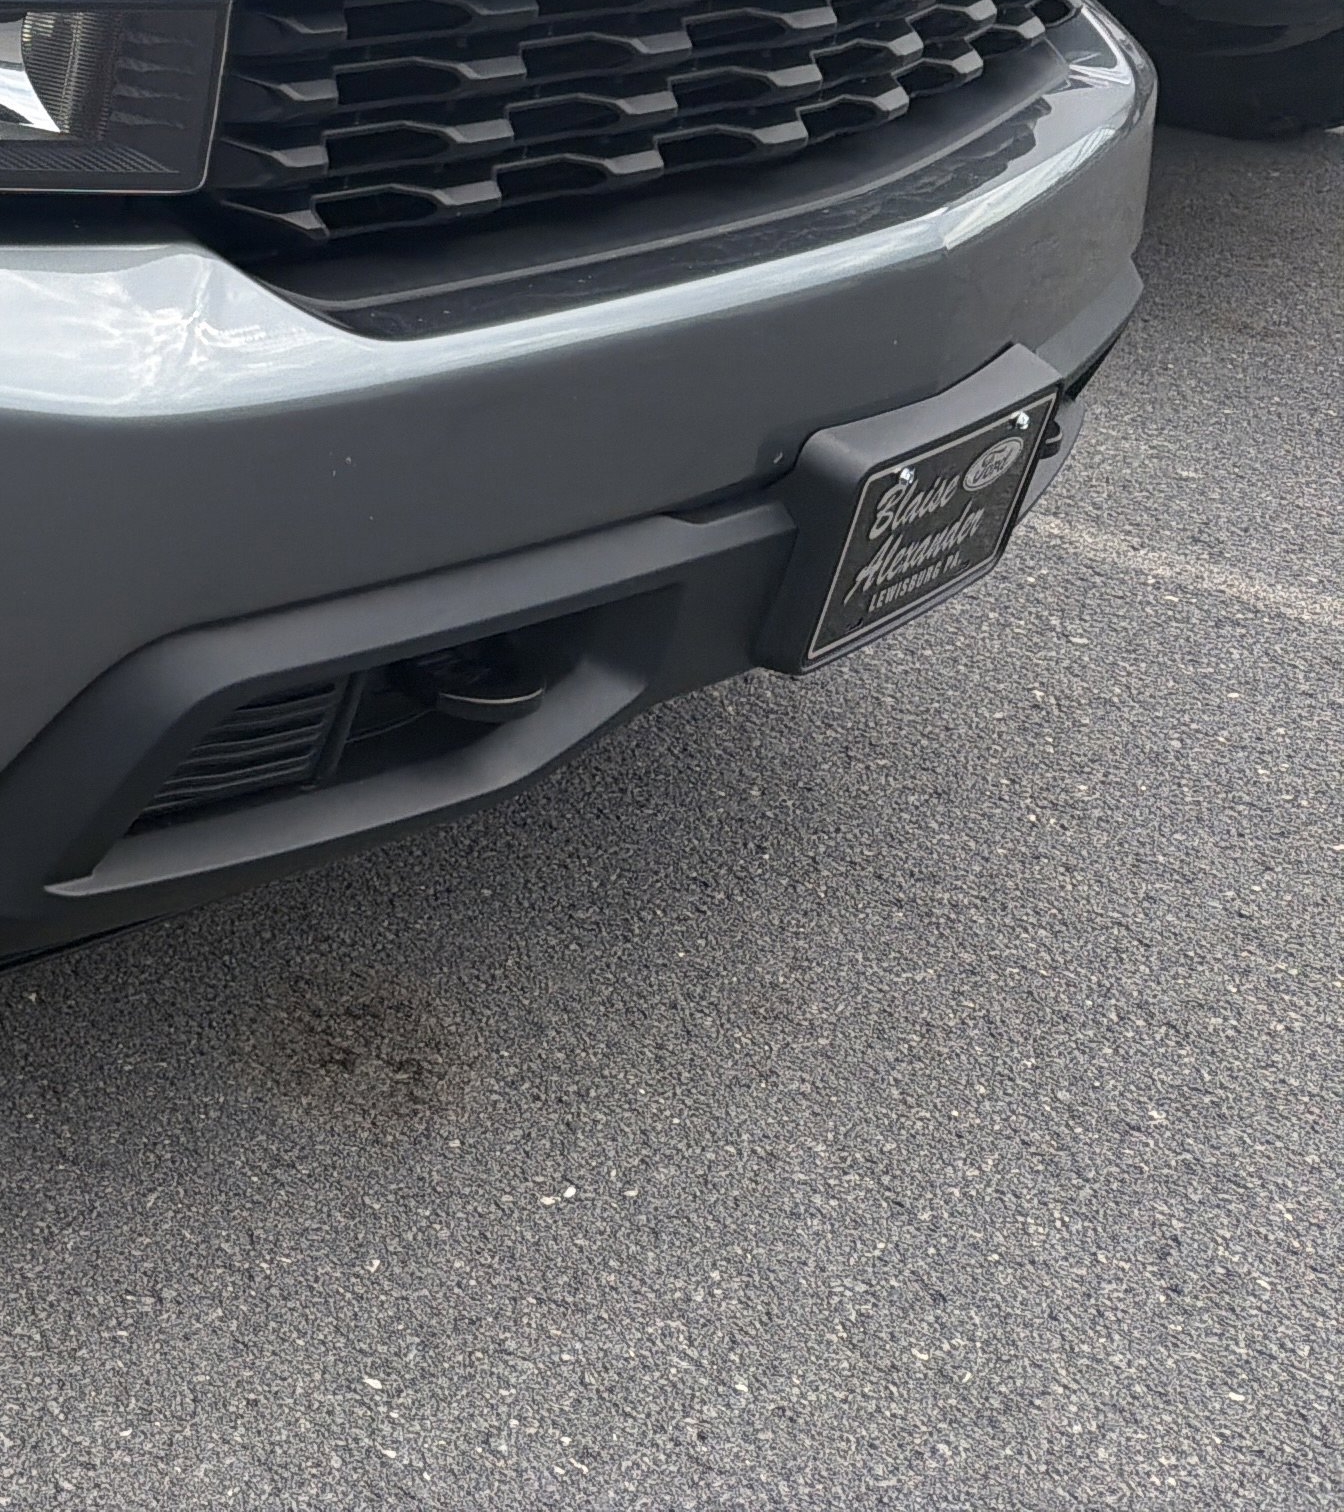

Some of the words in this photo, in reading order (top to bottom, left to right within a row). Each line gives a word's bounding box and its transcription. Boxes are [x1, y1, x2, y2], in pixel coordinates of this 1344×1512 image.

[868, 474, 961, 540] Blaise
[843, 499, 984, 605] Alexander
[868, 560, 942, 612] LEWISBURG
